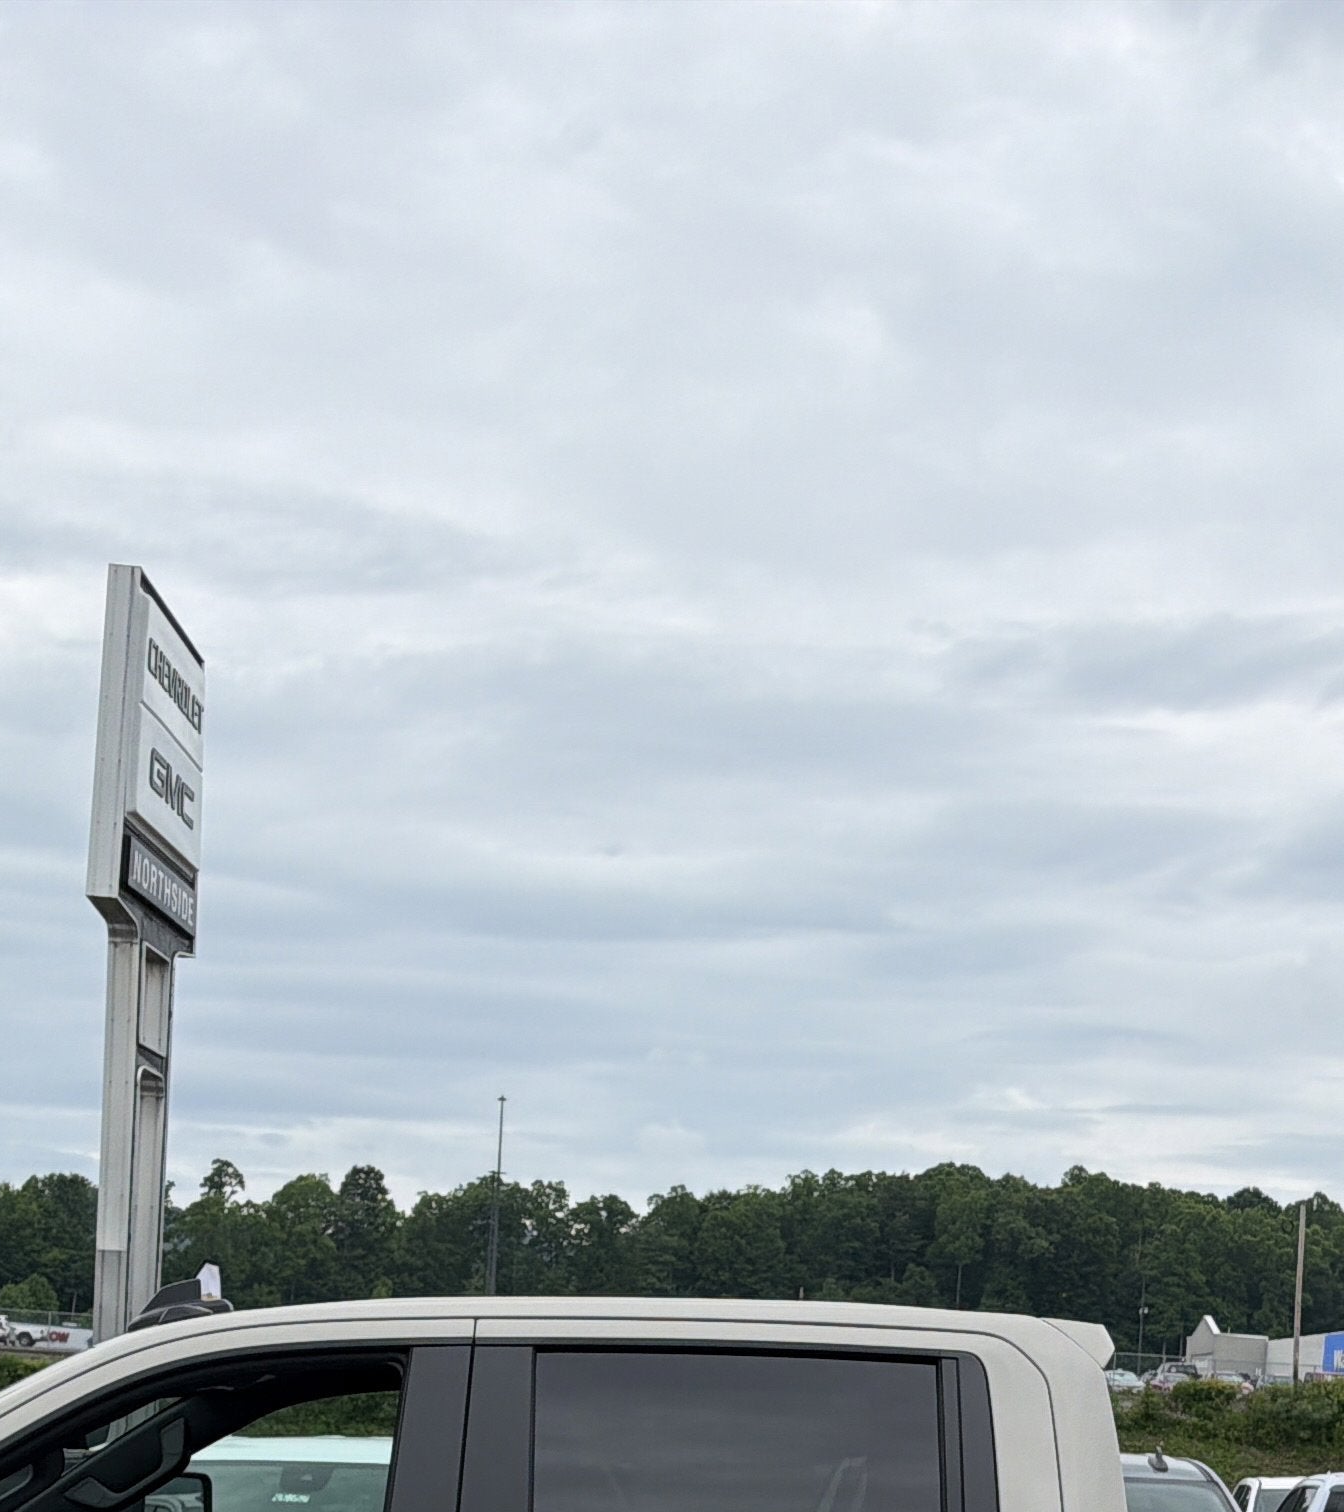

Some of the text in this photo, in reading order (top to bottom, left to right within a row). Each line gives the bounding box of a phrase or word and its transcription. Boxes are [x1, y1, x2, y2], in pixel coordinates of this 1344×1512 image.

[147, 637, 204, 735] CHEVROLET
[149, 747, 195, 831] GMC
[132, 850, 195, 927] NORTHSIDE
